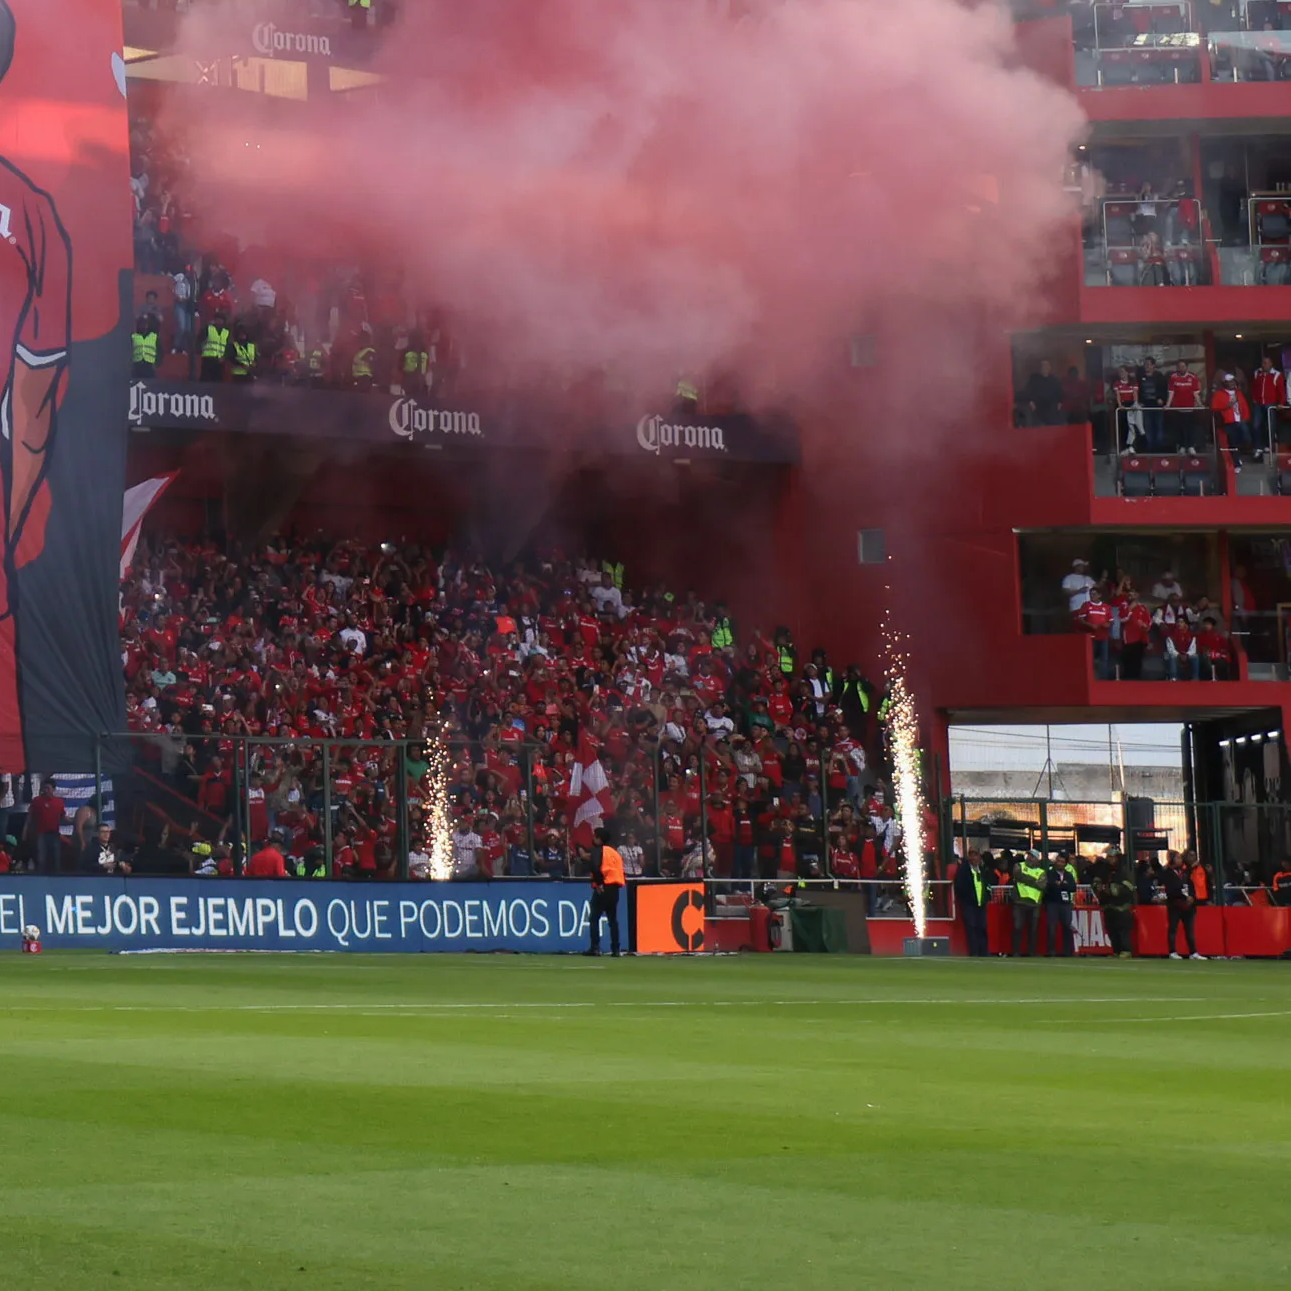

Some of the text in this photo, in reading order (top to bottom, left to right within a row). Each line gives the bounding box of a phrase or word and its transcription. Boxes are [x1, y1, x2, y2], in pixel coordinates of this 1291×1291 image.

[253, 23, 331, 56] Corona
[389, 396, 482, 440] Corona
[637, 413, 725, 455] Corona
[45, 894, 161, 935] MEJOR
[170, 896, 318, 938] EJEMPLO
[327, 898, 392, 946] QUE
[400, 898, 550, 939] PODEMOS
